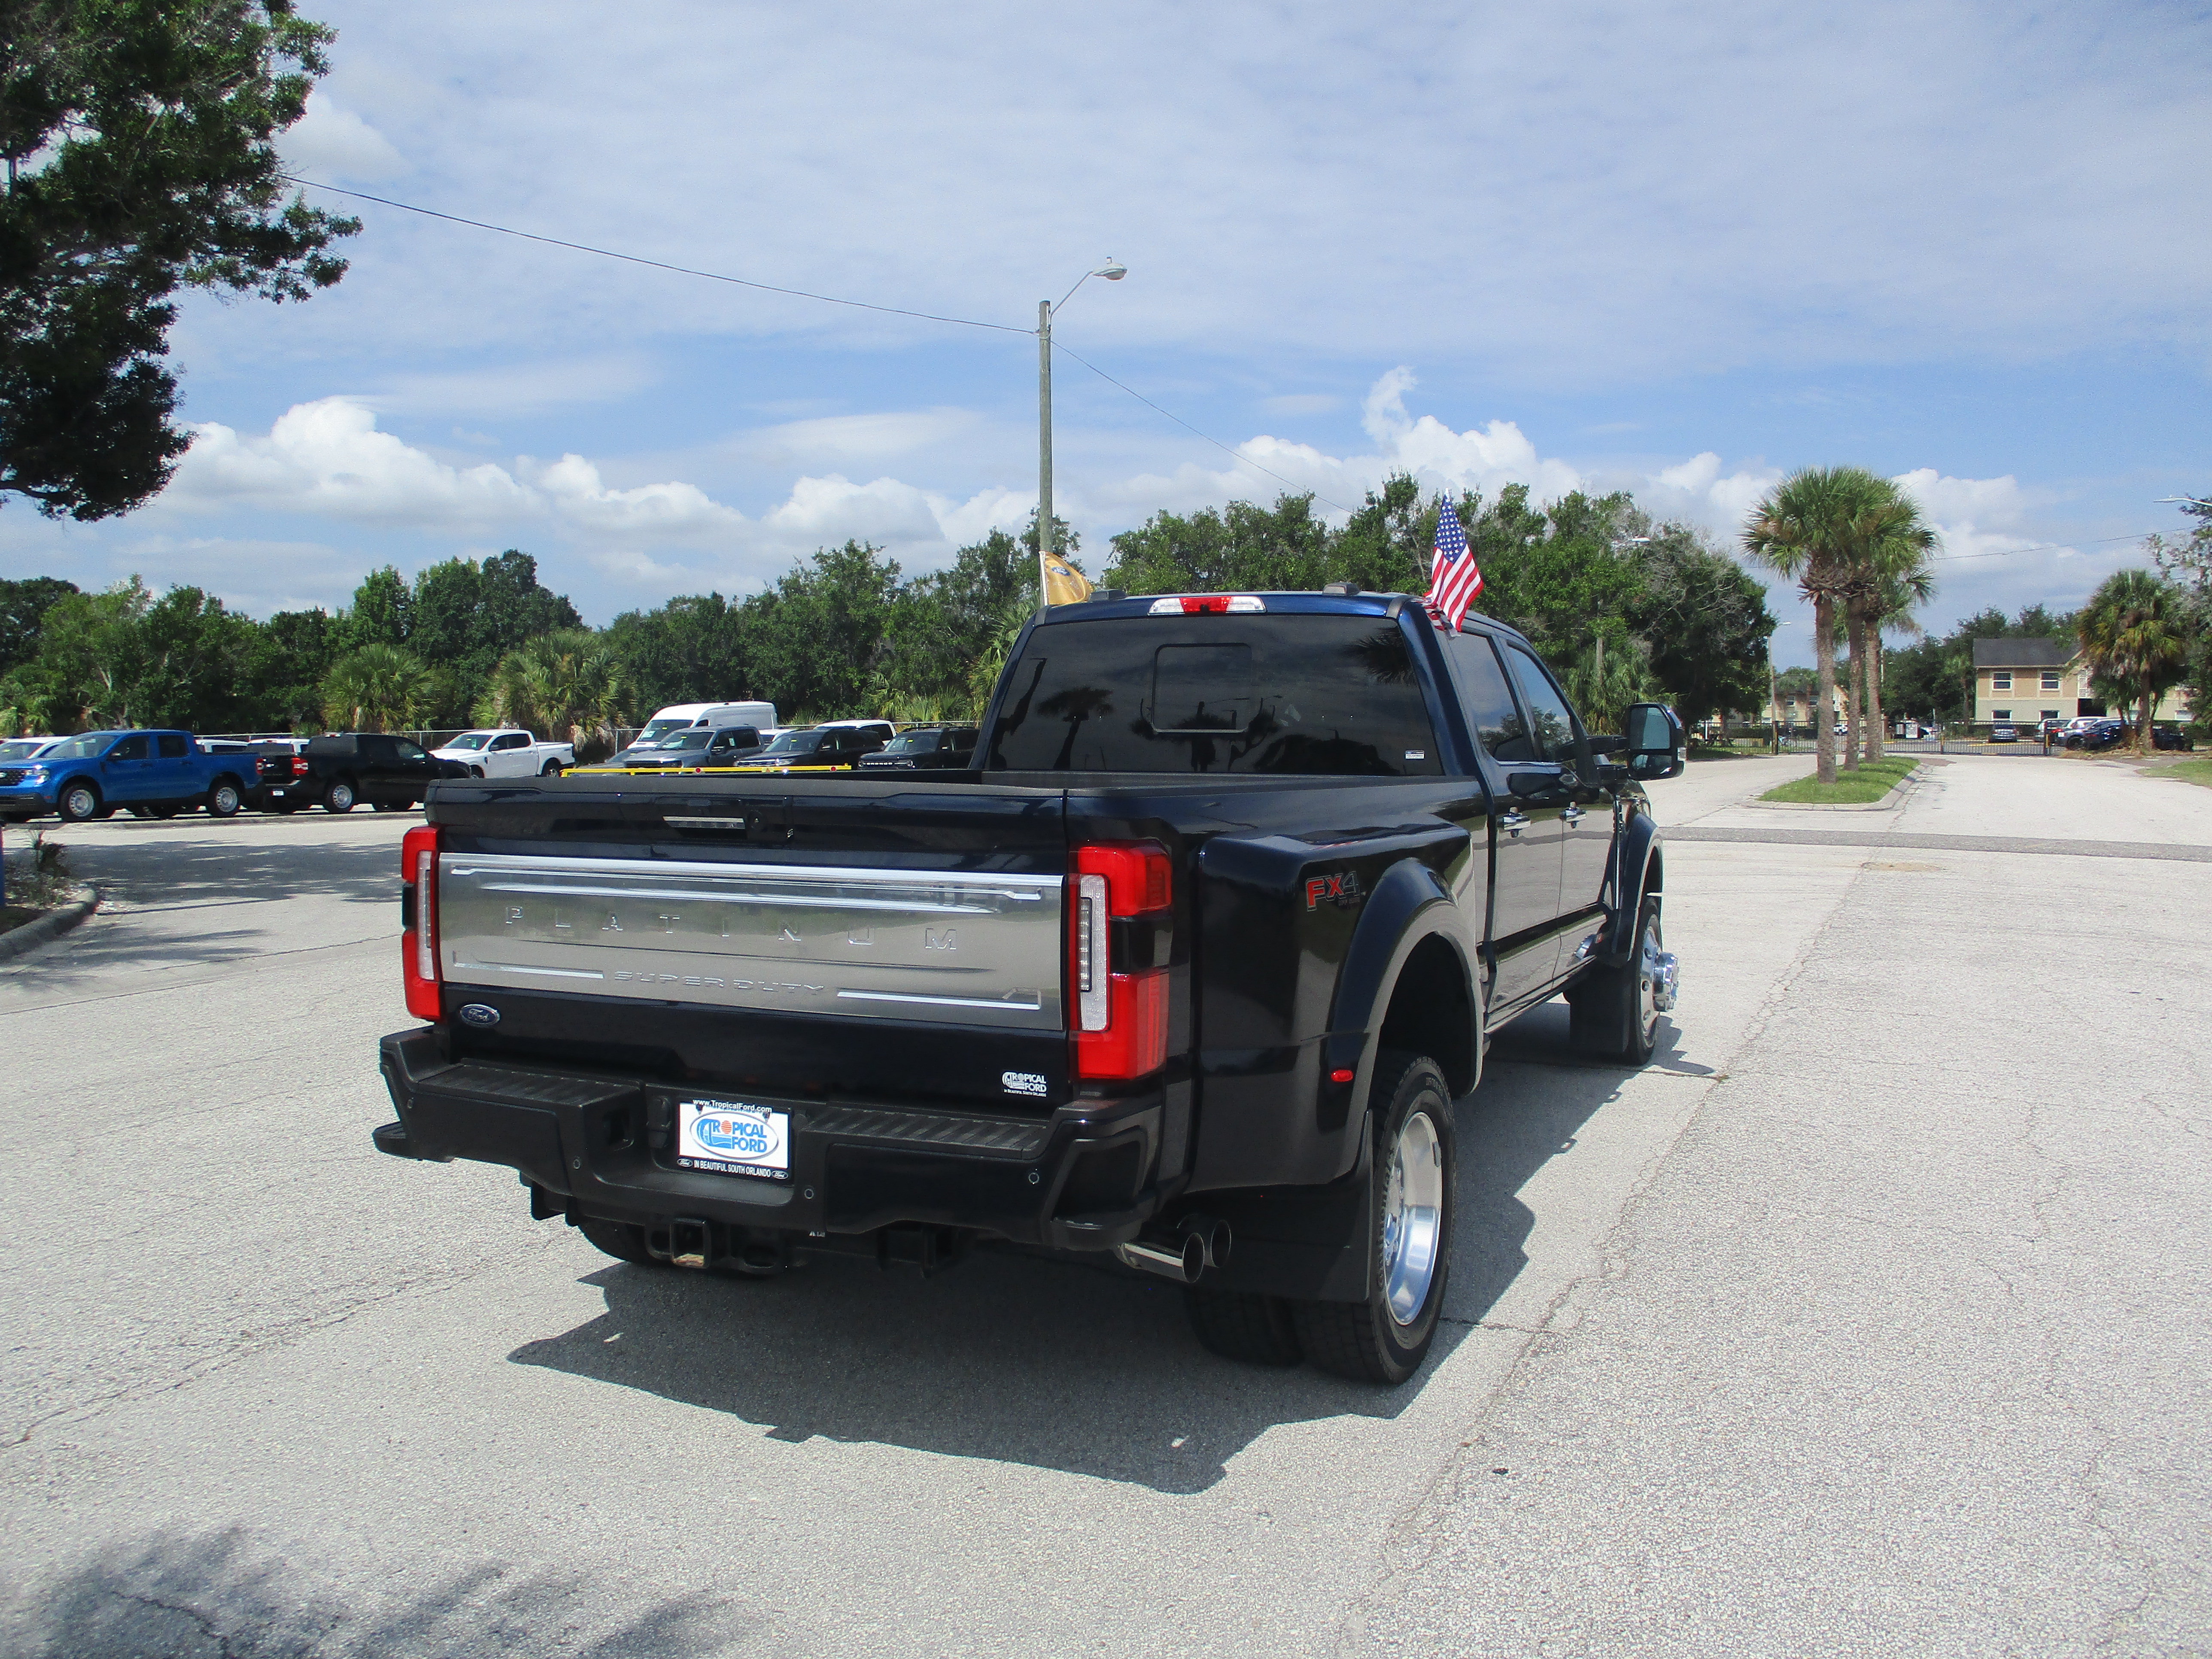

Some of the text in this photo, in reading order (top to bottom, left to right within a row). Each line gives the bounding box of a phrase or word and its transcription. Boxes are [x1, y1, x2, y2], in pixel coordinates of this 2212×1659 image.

[1305, 871, 1360, 912] FX4
[505, 905, 957, 950] PLATINUM
[614, 971, 826, 995] SUPER DUTY
[1024, 1082, 1047, 1092] FORD
[692, 1099, 772, 1113] www.TropicalFord.com
[732, 1136, 768, 1153] FORD
[694, 1160, 700, 1168] IN
[700, 1161, 727, 1172] BEAUTIFUL
[728, 1164, 745, 1174] SOUTH
[746, 1167, 771, 1177] ORLANDO
